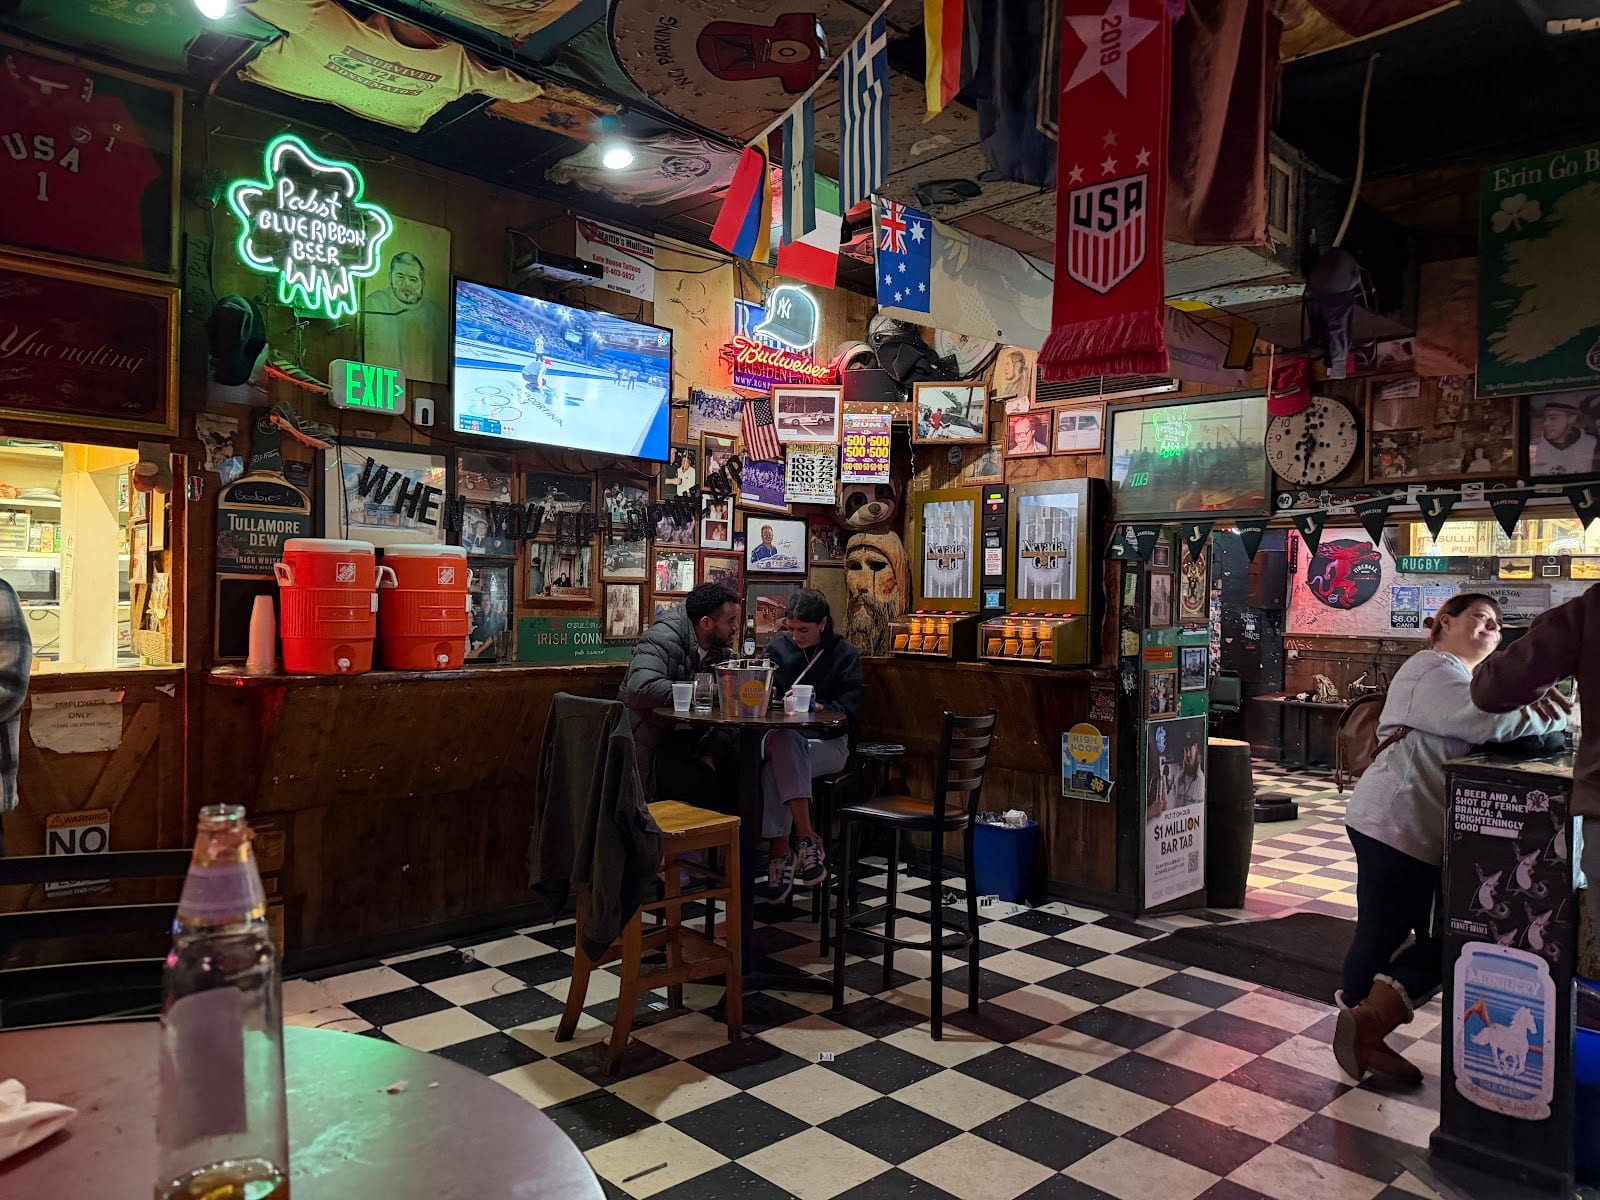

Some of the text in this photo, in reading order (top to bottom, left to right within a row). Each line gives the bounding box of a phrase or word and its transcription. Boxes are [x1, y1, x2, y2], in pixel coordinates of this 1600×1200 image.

[654, 15, 678, 66] PARKING
[1100, 14, 1123, 67] 2019
[366, 56, 437, 80] SURVIVED
[368, 68, 400, 82] Y2K
[668, 68, 694, 87] NO
[1, 132, 80, 173] USA
[1492, 167, 1542, 192] Erin
[1549, 153, 1578, 180] Go
[36, 171, 49, 202] 1
[278, 177, 342, 221] Pabst
[1073, 180, 1143, 233] USA
[258, 210, 365, 247] BLUE RIBBON
[293, 240, 340, 266] BEER
[626, 240, 654, 255] Mulligan
[0, 322, 144, 375] Yuengling
[733, 335, 830, 378] Budweiser
[345, 361, 397, 410] EXIT
[1280, 418, 1291, 428] 10
[1275, 434, 1282, 442] 9
[1276, 450, 1283, 460] 8
[1286, 463, 1294, 473] 7
[359, 456, 466, 532] WHEN
[1359, 508, 1382, 517] JAMESON
[227, 513, 300, 534] TULLAMORE
[250, 533, 279, 547] DEW
[927, 540, 964, 555] Nevada
[1023, 537, 1066, 553] Nevada
[236, 556, 257, 564] IRISH
[1402, 558, 1440, 571] RUGBY
[1352, 564, 1378, 574] FIREBALL
[1487, 589, 1522, 598] JAMESON
[537, 633, 568, 645] IRISH
[68, 711, 91, 719] ONLY
[1073, 735, 1098, 743] HIGH
[1071, 744, 1100, 753] NOON
[1456, 788, 1517, 803] A BEER AND A
[1455, 797, 1529, 813] SHOT OF FERNET
[1455, 805, 1503, 818] BRANCA: A
[64, 812, 108, 823] WARNING
[1455, 813, 1524, 830] FRIGHTENINGLY
[1154, 816, 1200, 841] $1 MILLION
[1455, 822, 1478, 832] GOOD
[49, 827, 107, 855] NO
[1161, 834, 1193, 855] BAR TAB
